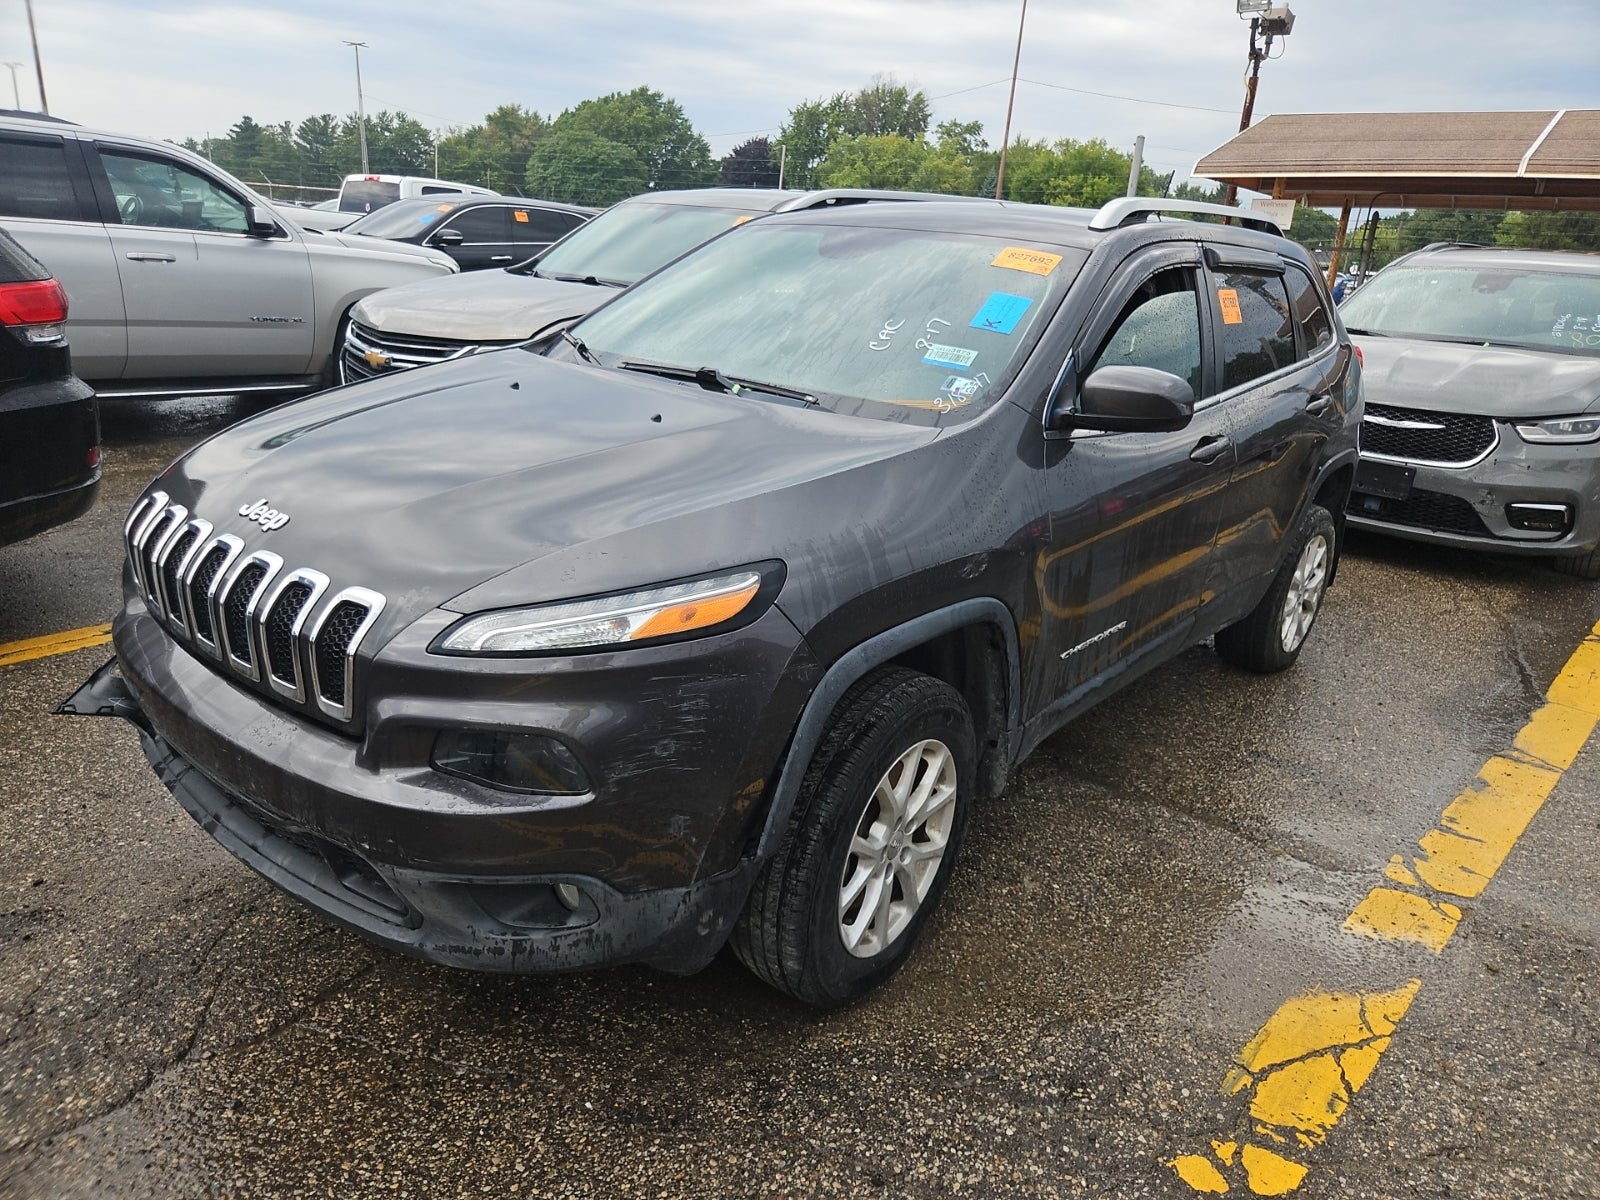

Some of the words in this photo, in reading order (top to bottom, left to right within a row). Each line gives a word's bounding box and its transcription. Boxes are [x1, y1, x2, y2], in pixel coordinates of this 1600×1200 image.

[1007, 251, 1054, 266] 827692
[869, 319, 906, 351] CAC
[915, 318, 951, 350] 8-17
[239, 498, 290, 532] Jeep
[1060, 620, 1127, 659] CHEROKEE
